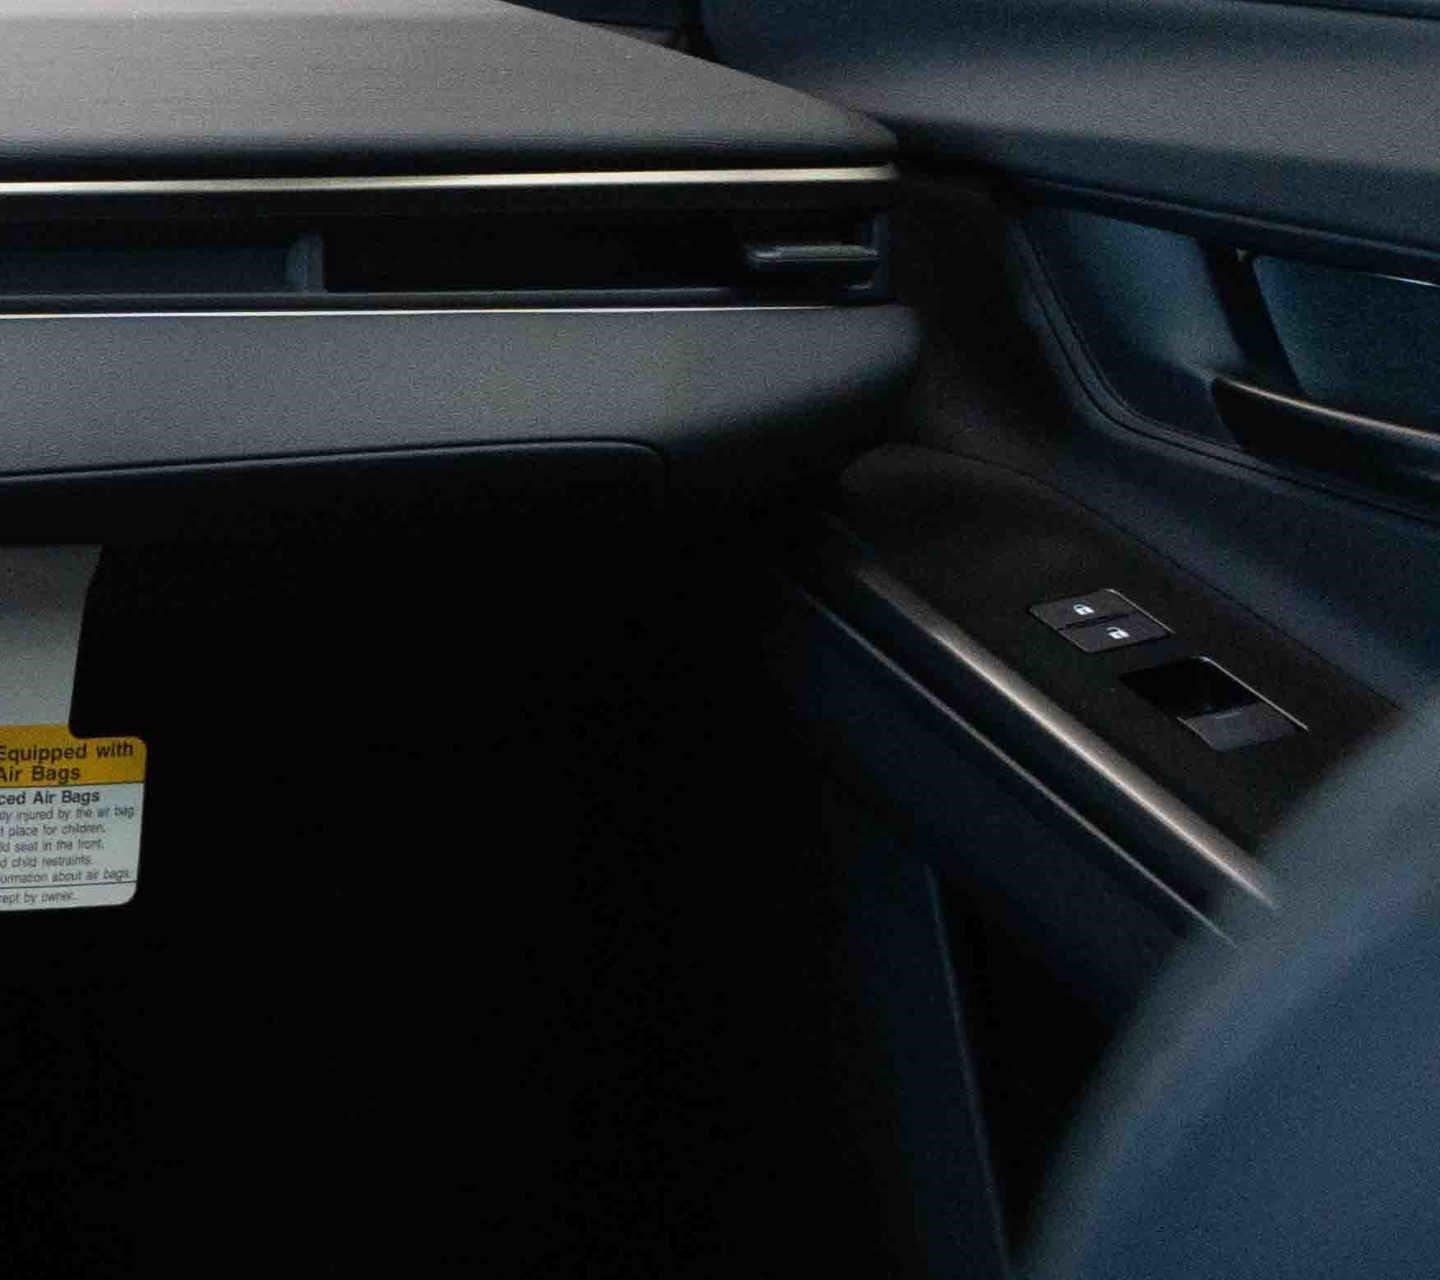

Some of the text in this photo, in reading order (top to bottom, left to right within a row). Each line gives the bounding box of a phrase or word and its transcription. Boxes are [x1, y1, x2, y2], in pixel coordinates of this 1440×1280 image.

[96, 741, 134, 758] with
[32, 765, 81, 784] Bags
[33, 790, 57, 805] Air
[61, 789, 101, 806] Bags
